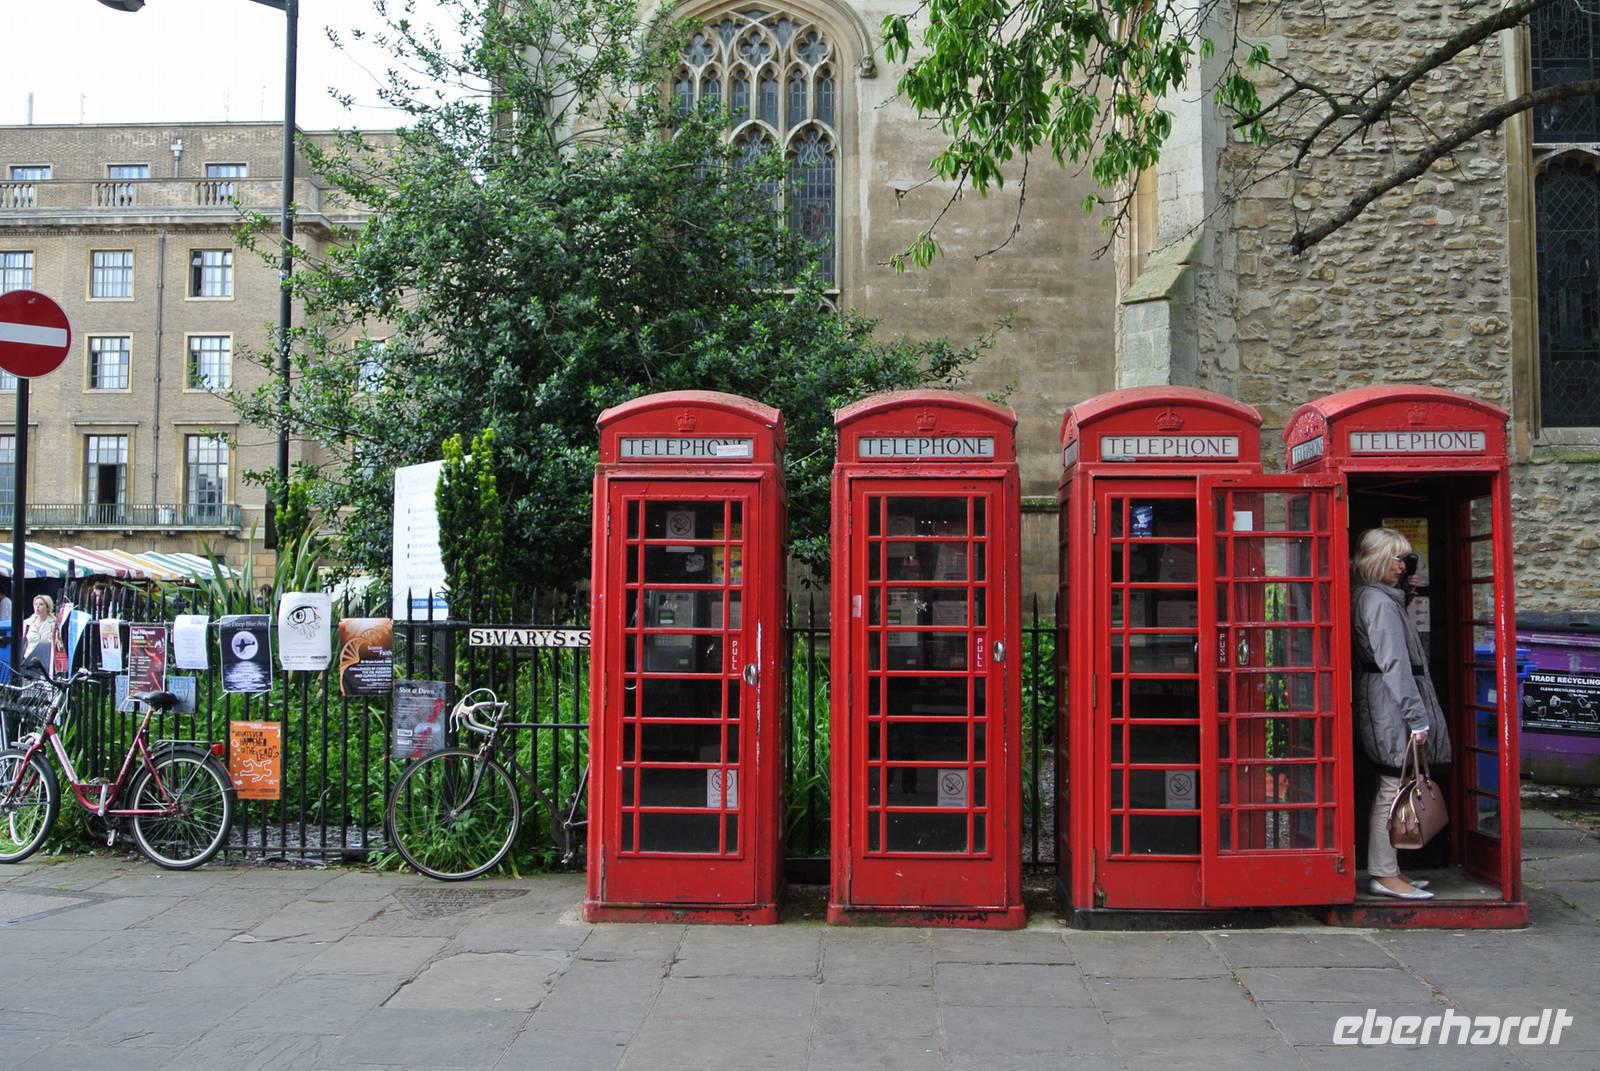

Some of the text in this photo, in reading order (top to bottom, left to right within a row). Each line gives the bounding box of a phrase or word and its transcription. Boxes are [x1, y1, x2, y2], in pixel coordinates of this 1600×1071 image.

[864, 438, 988, 455] TELEPHONE
[1107, 438, 1232, 455] TELEPHONE
[1356, 432, 1480, 450] TELEPHONE
[1530, 675, 1600, 686] TRADE RECYCLING
